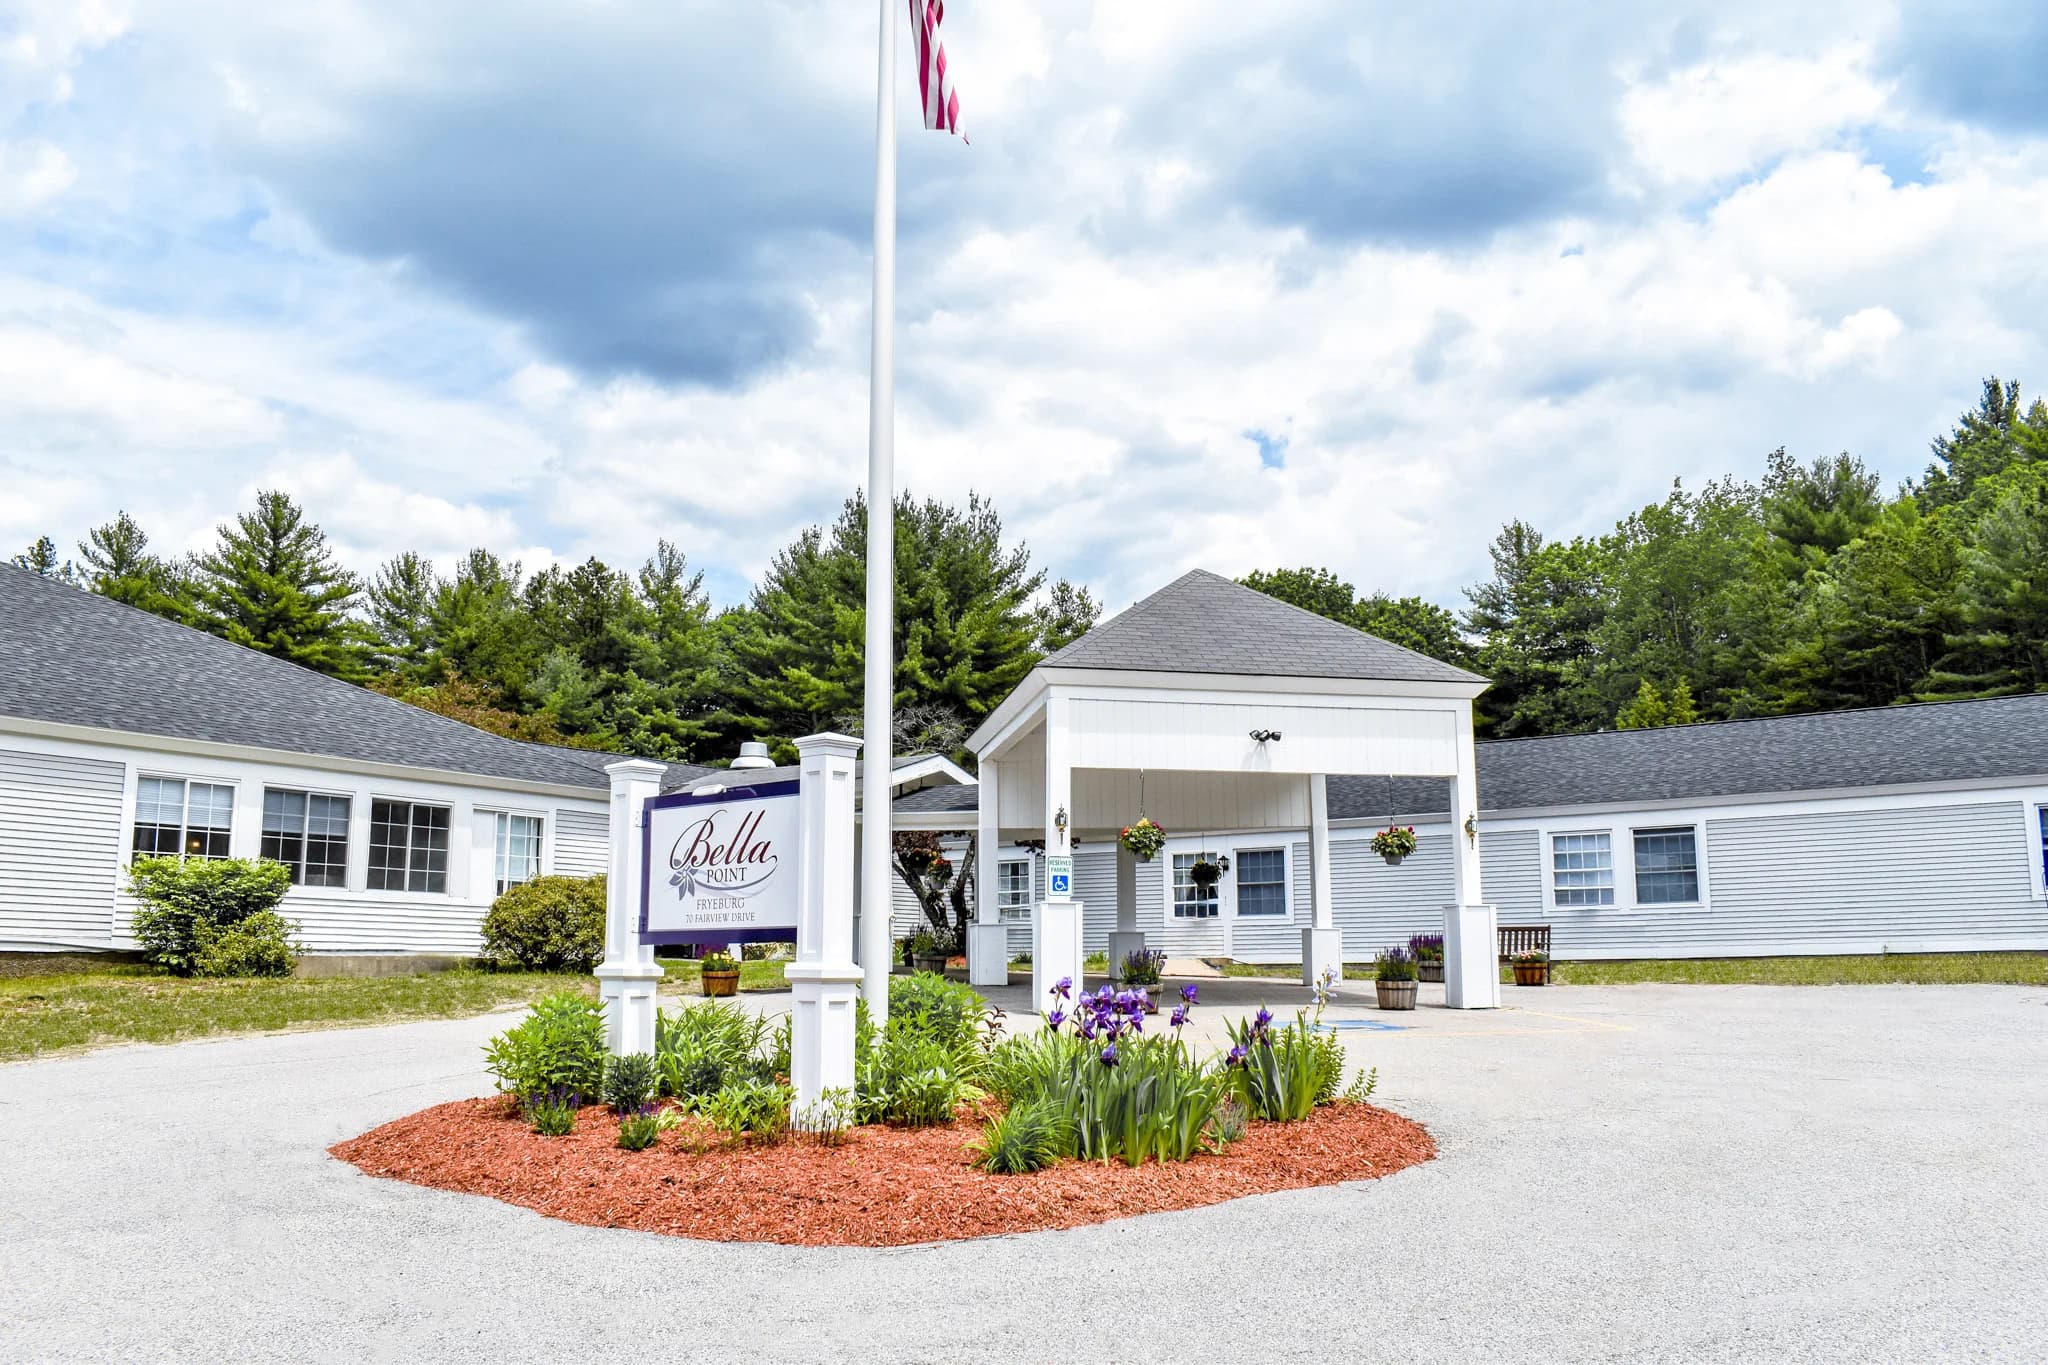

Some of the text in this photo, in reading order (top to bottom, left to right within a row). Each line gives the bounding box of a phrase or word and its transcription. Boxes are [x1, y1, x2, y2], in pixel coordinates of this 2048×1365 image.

[670, 809, 777, 869] Bella
[706, 867, 748, 883] POINT
[696, 897, 745, 910] FRYEBURG
[686, 911, 756, 924] 70 FAIRVIEW DRIVE
